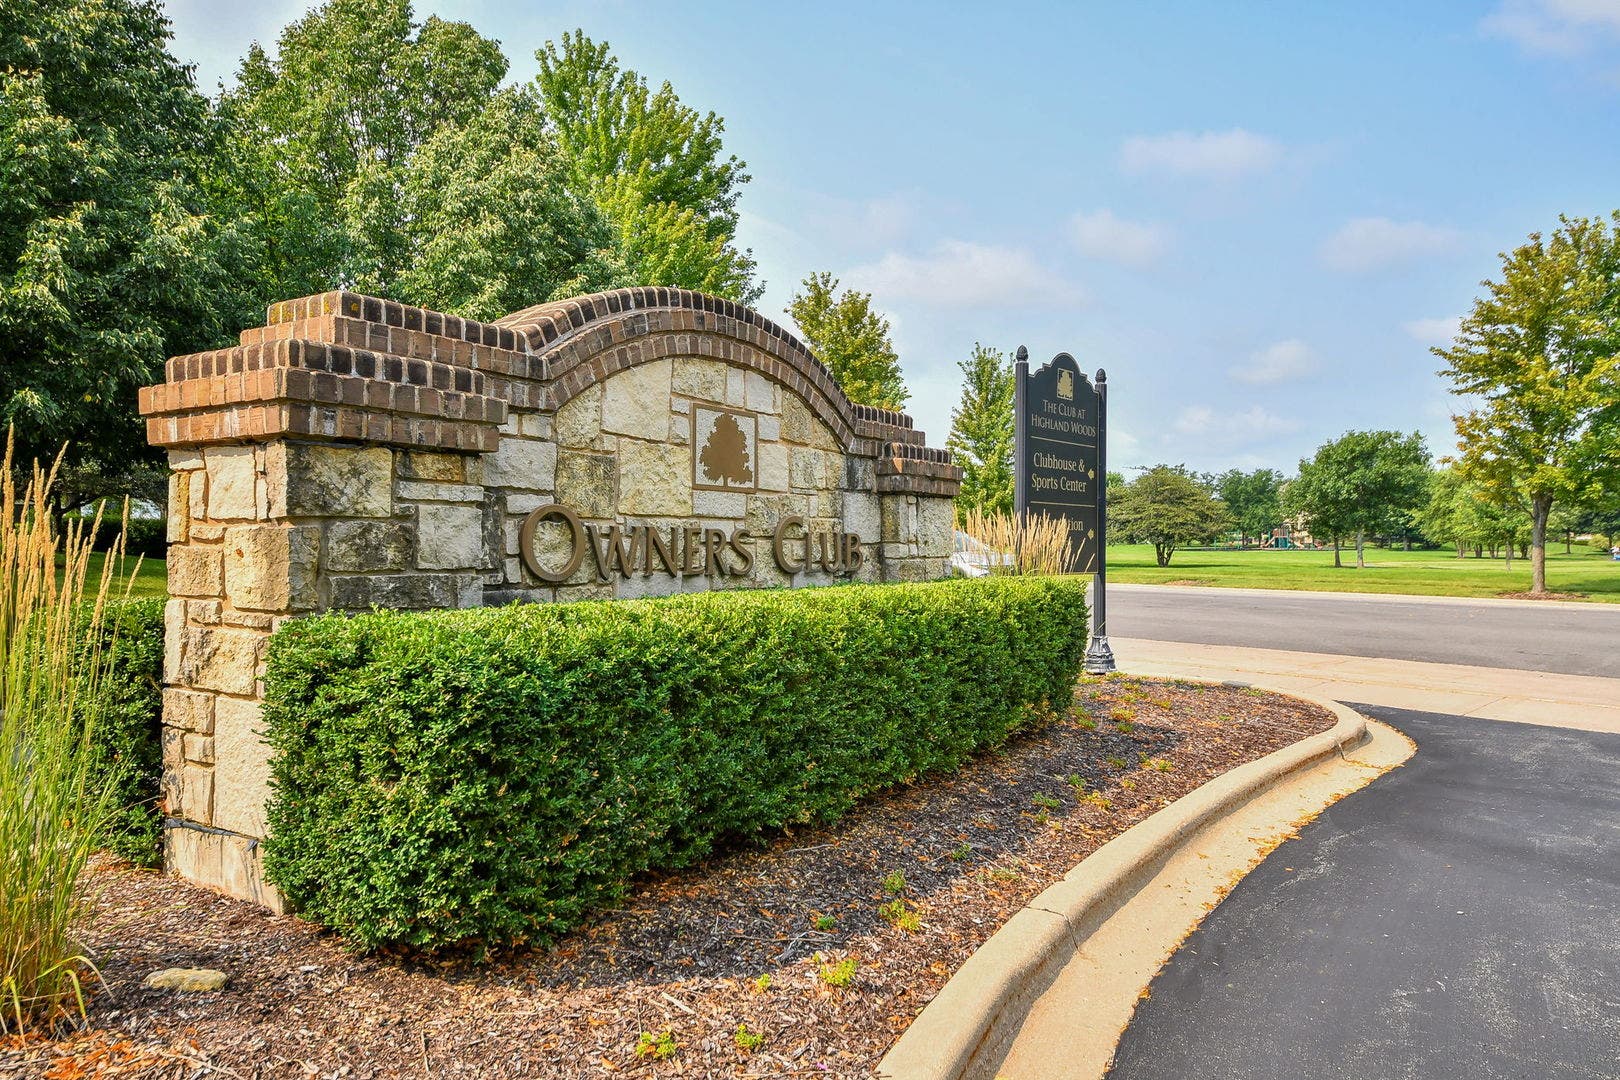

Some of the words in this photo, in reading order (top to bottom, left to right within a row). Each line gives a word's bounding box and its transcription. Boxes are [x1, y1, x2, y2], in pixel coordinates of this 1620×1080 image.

[1042, 400, 1057, 414] THE
[1058, 403, 1076, 418] CLUB
[1077, 409, 1086, 419] AT
[1031, 414, 1069, 432] HIGHLAND
[1071, 421, 1096, 437] WOODS
[1033, 452, 1077, 472] Clubhouse
[1078, 459, 1085, 473] &
[1031, 473, 1058, 491] Sports
[1060, 476, 1087, 492] Center
[519, 503, 754, 583] OWNERS
[774, 514, 864, 575] CLUB
